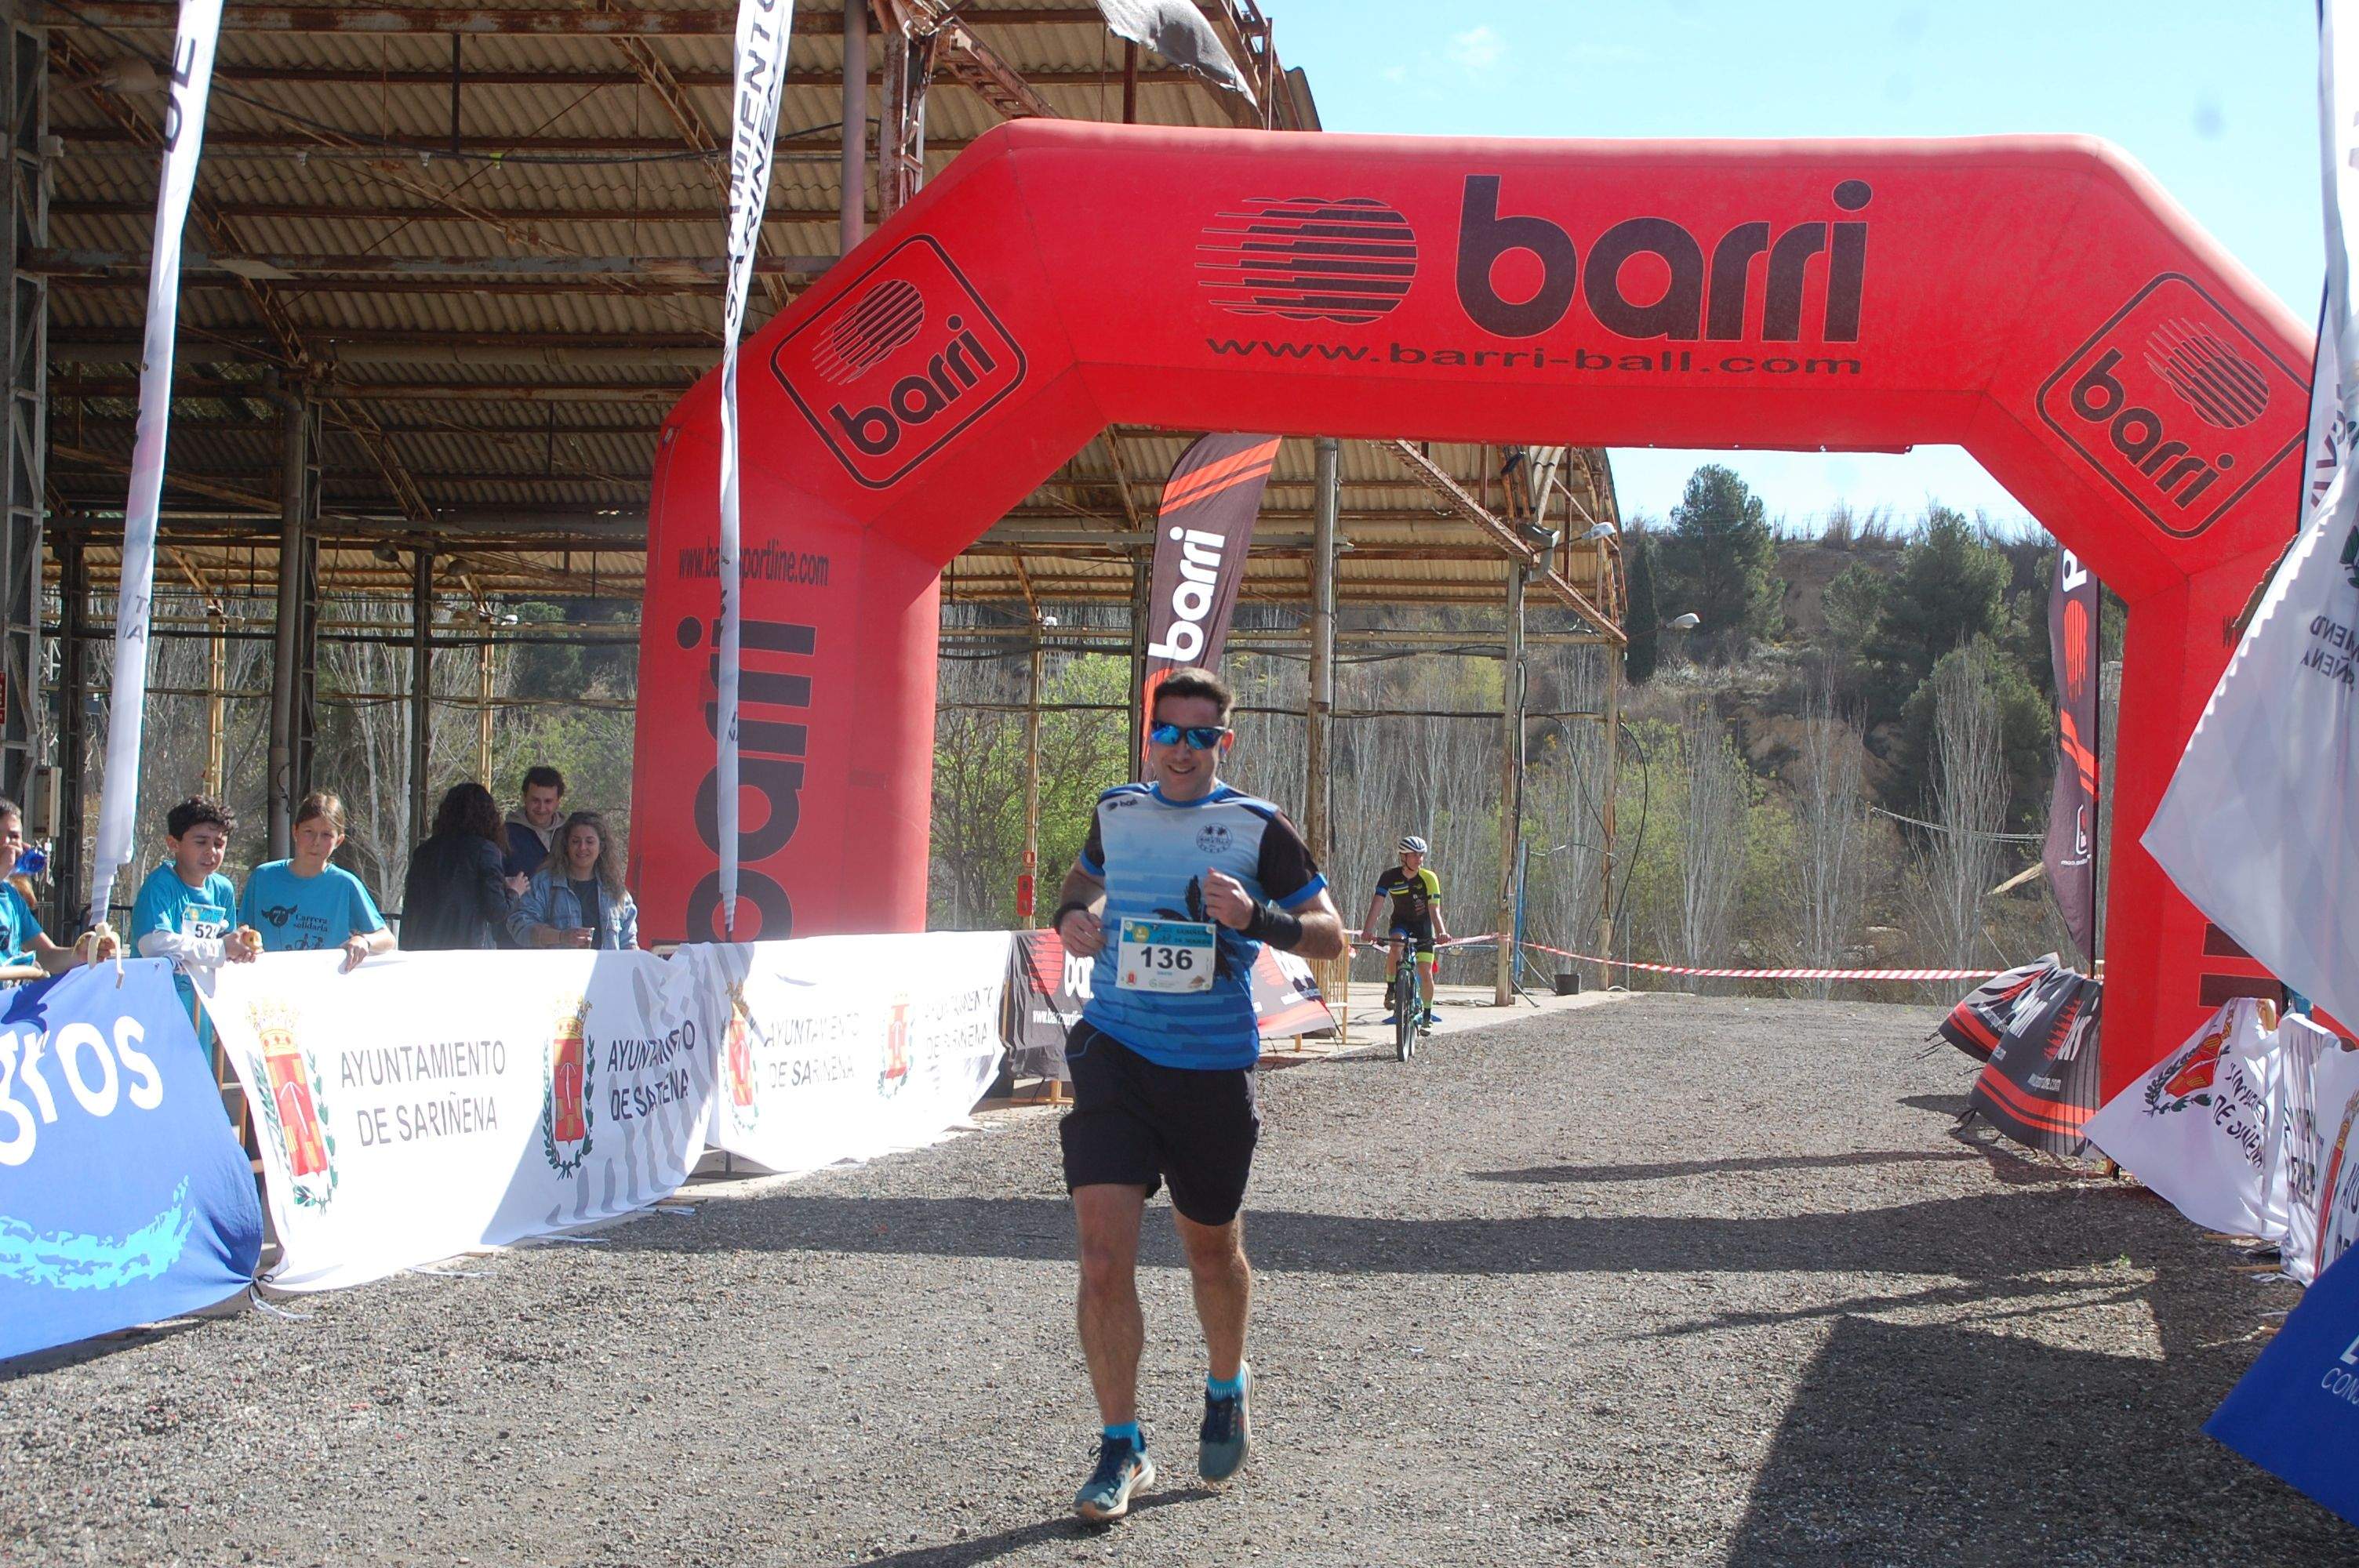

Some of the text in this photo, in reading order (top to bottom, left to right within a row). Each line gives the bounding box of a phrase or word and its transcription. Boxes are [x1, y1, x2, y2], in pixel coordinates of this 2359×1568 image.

[1456, 174, 1874, 343] barri
[1205, 337, 1863, 375] www.barri-ball.com
[828, 314, 998, 456] barri
[2070, 347, 2235, 510] barri
[1147, 526, 1226, 662] barri
[1140, 946, 1194, 971] 136
[341, 1040, 506, 1089] AYUNTAMIENTO
[357, 1090, 498, 1147] DE SARIÑENA
[610, 1088, 633, 1121] DE
